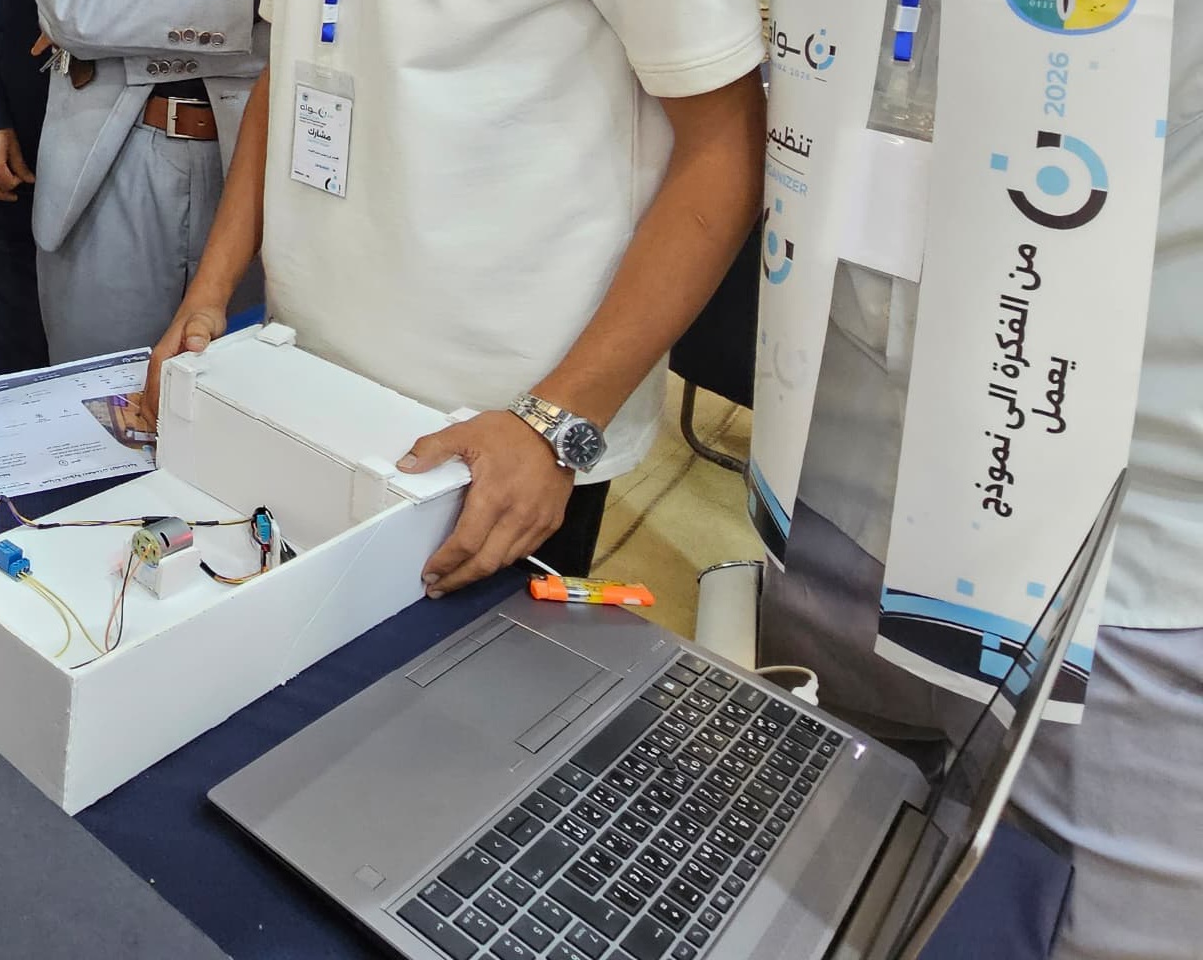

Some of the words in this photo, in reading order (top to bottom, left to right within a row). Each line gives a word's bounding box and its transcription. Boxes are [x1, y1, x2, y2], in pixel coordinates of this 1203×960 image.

[1043, 52, 1069, 118] 2026
[307, 127, 332, 141] مشارك
[1011, 243, 1042, 290] من
[993, 295, 1031, 378] الفكرة
[1032, 356, 1077, 434] يعمل
[974, 431, 1014, 518] نموذج
